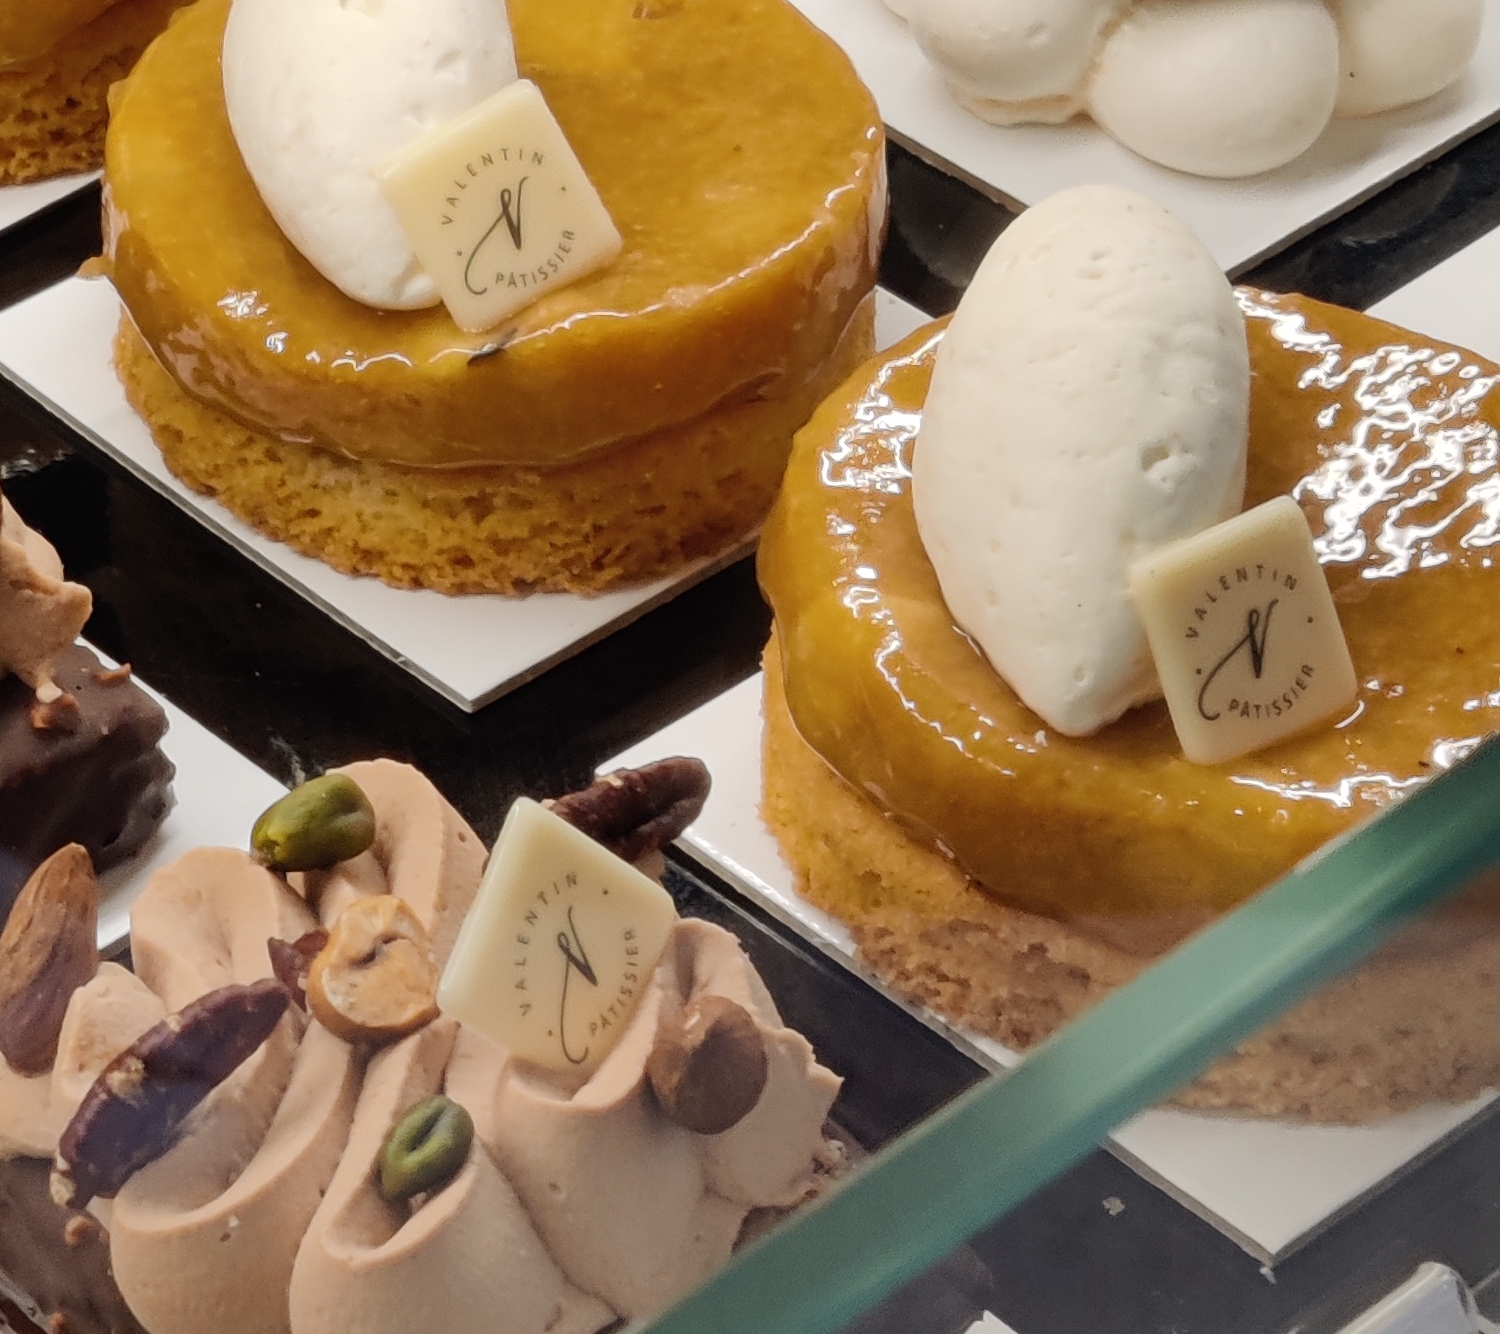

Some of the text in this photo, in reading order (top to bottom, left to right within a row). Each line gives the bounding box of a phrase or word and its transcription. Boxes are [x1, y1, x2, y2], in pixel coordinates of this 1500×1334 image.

[441, 148, 544, 225] VALENTIN
[1185, 564, 1297, 639] VALENTIN
[514, 871, 577, 1017] VALENTIN
